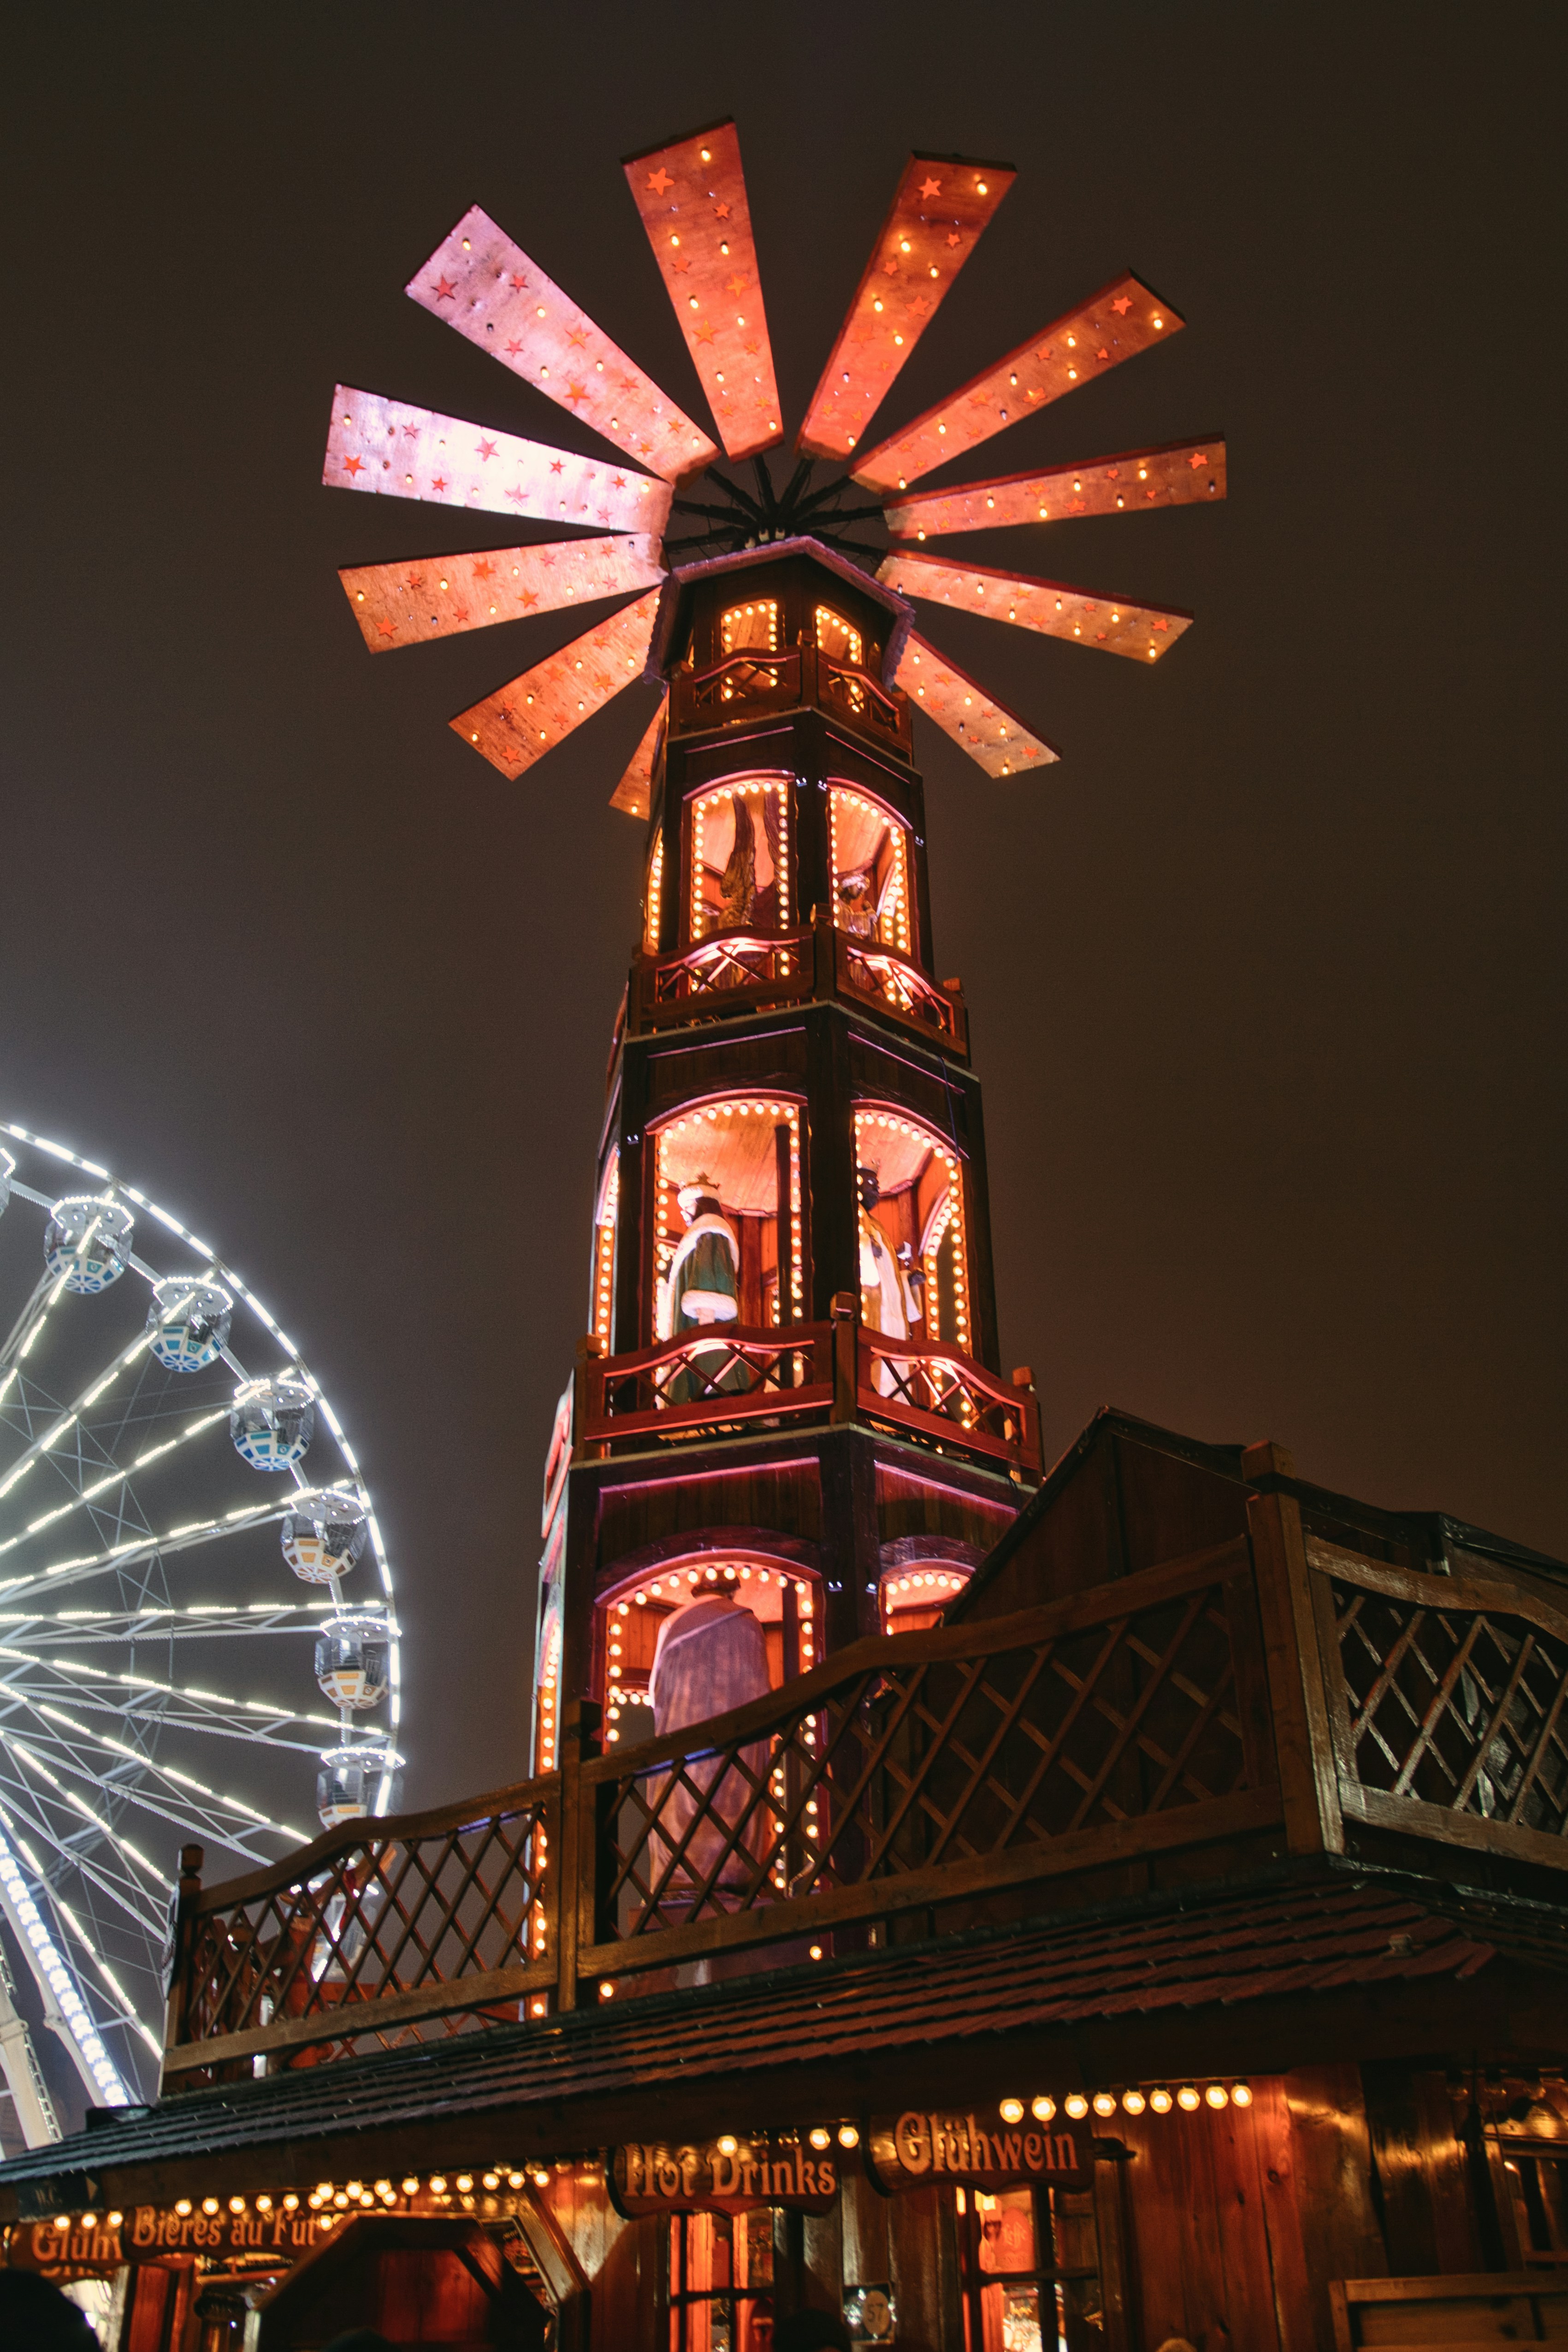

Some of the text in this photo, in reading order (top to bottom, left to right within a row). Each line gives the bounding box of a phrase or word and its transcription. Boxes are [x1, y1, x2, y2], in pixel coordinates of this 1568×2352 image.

[894, 2111, 1080, 2175] Glühwein
[622, 2144, 836, 2198] Hot Drinks
[231, 2218, 263, 2246] au
[867, 2303, 883, 2322] 57
